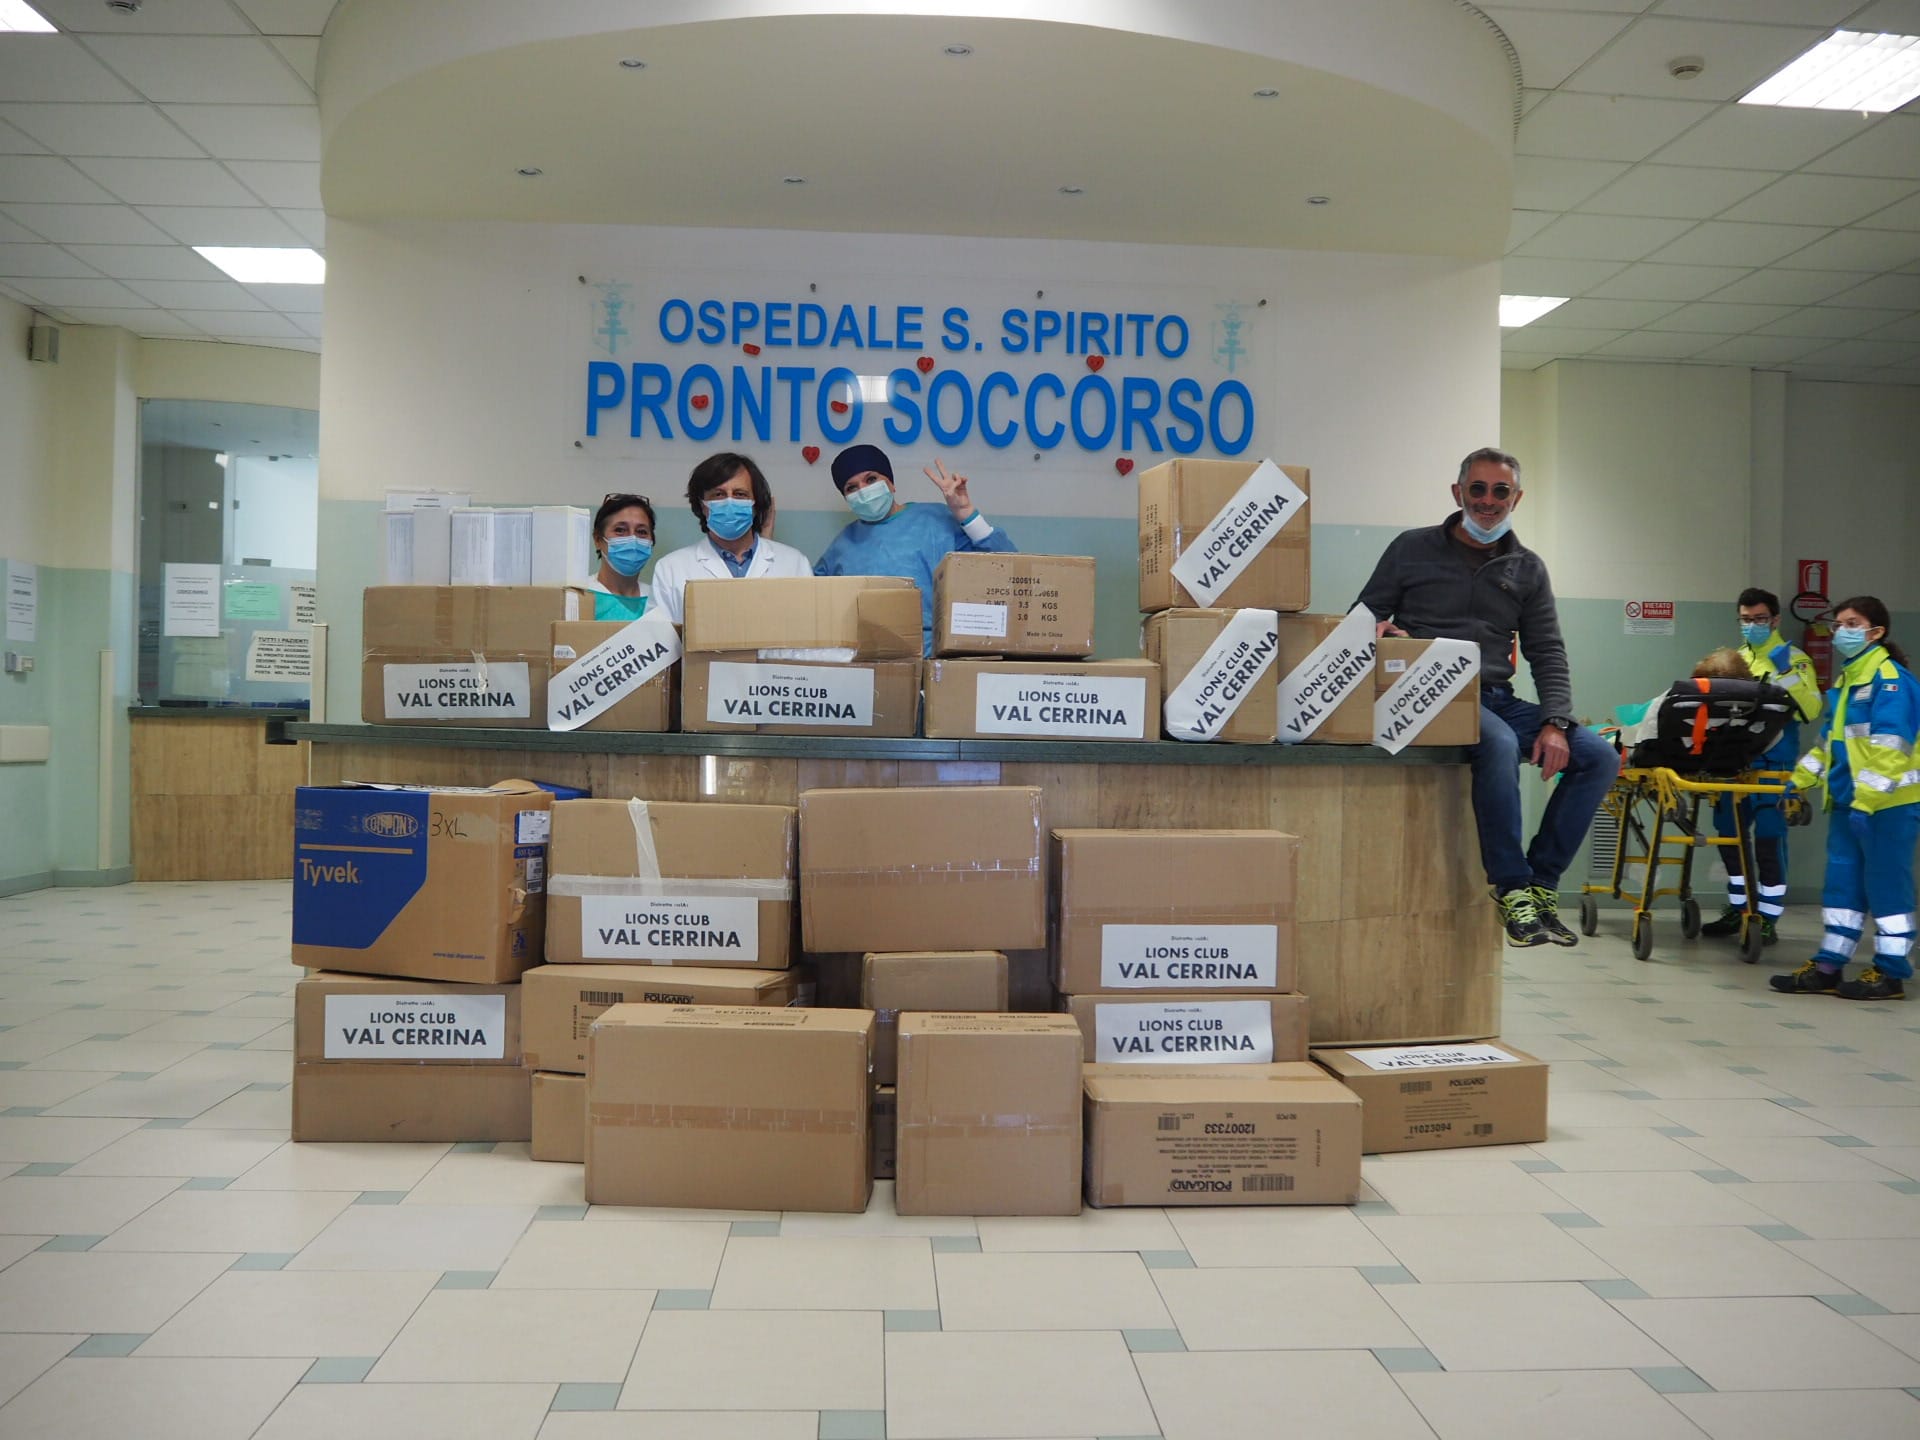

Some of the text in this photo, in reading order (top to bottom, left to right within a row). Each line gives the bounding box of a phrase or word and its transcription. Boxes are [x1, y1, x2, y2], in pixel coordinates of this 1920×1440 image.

[659, 299, 1190, 358] OSPEDALE S. SPIRITO
[586, 361, 1254, 455] PRONTO SOCCORSO
[1203, 526, 1236, 561] LIONS
[1234, 501, 1259, 528] CLUB
[1197, 558, 1231, 589] VAL
[1228, 494, 1289, 558] CERRINA
[1042, 602, 1058, 610] KGS
[1041, 614, 1058, 622] KGS
[568, 644, 636, 694] LIONS CLUB
[1195, 641, 1250, 706] LIONS CLUB
[1294, 648, 1352, 706] LIONS CLUB
[419, 678, 456, 689] LIONS
[557, 642, 669, 721] VAL CERRINA
[1190, 631, 1278, 734] VAL CERRINA
[1286, 641, 1376, 733] VAL CERRINA
[1389, 661, 1443, 716] LIONS CLUB
[397, 692, 516, 708] VAL CERRINA
[748, 685, 828, 699] LIONS CLUB
[1018, 690, 1099, 704] LIONS CLUB
[1381, 655, 1472, 742] VAL CERRINA
[723, 699, 857, 719] VAL CERRINA
[992, 704, 1127, 726] VAL CERRINA
[431, 812, 467, 838] 3XL
[299, 858, 360, 888] Tyvek
[625, 913, 710, 926] LIONS CLUB
[598, 928, 741, 948] VAL CERRINA
[1145, 947, 1229, 959] LIONS CLUB
[1118, 962, 1258, 980] VAL CERRINA
[370, 1012, 456, 1025] LIONS CLUB
[1139, 1019, 1223, 1032] LIONS CLUB
[342, 1028, 487, 1046] VAL CERRINA
[1112, 1034, 1255, 1054] VAL CERRINA
[1380, 1055, 1504, 1068] VAL CERRINA
[1395, 1052, 1432, 1060] LIONS
[1171, 1180, 1232, 1192] POLIGARD
